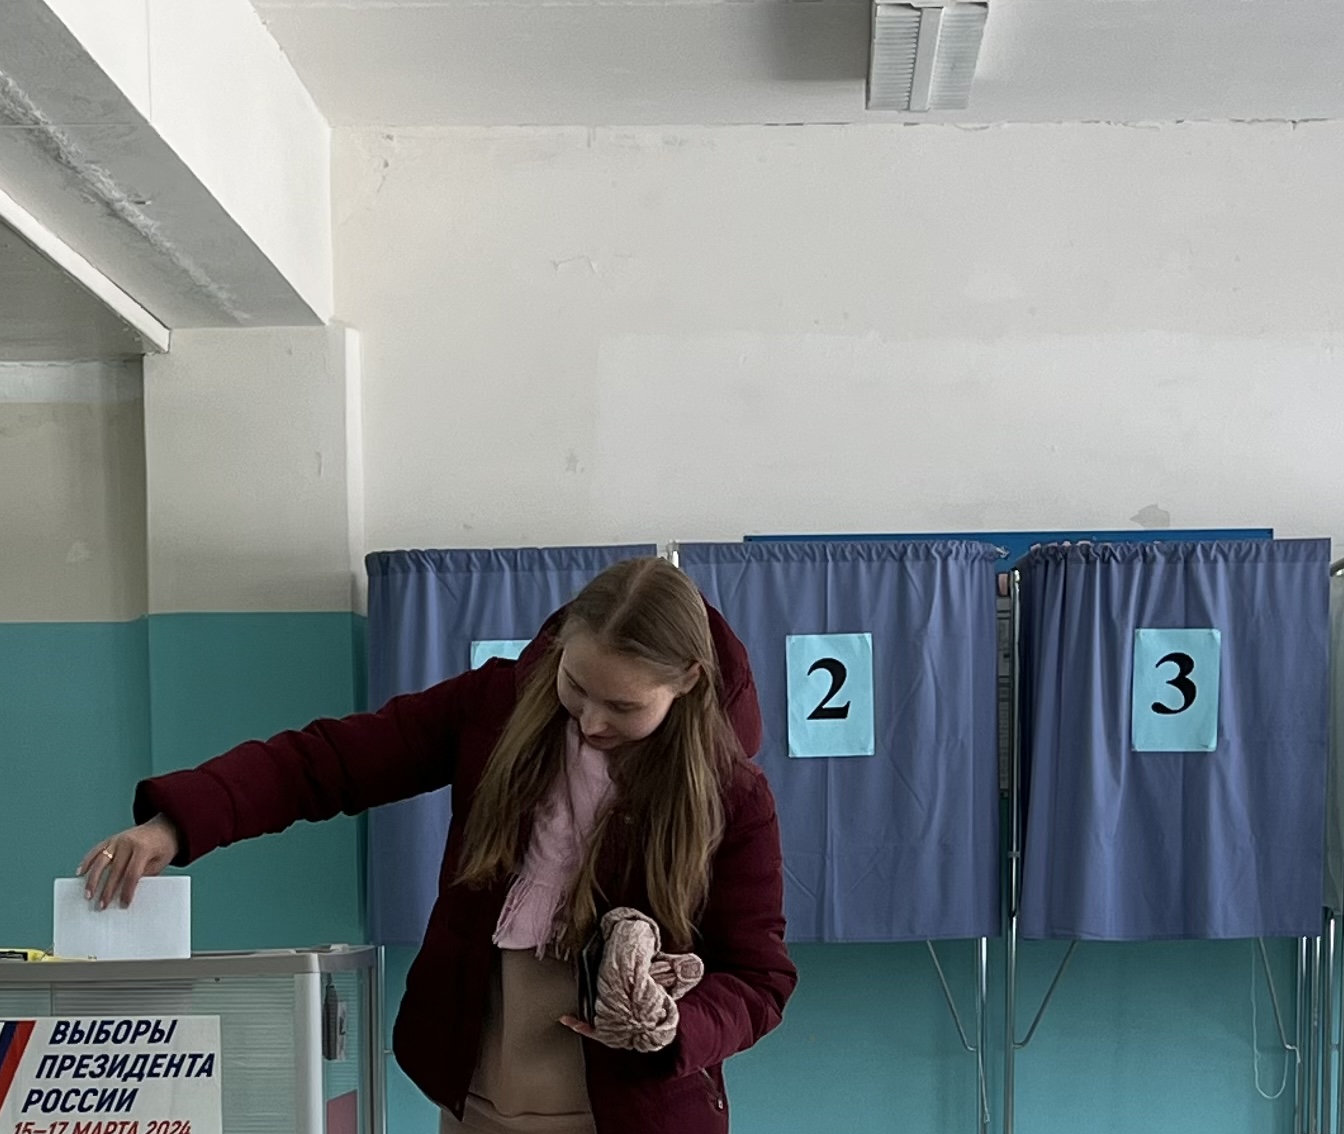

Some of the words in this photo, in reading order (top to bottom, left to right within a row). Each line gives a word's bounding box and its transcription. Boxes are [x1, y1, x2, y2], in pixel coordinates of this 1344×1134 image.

[806, 657, 851, 721] 2
[1150, 651, 1197, 715] 3
[48, 1019, 178, 1046] ВЫБОРЫ
[35, 1053, 215, 1082] ПРЕЗИДЕНТА
[21, 1087, 139, 1113] РОССИИ
